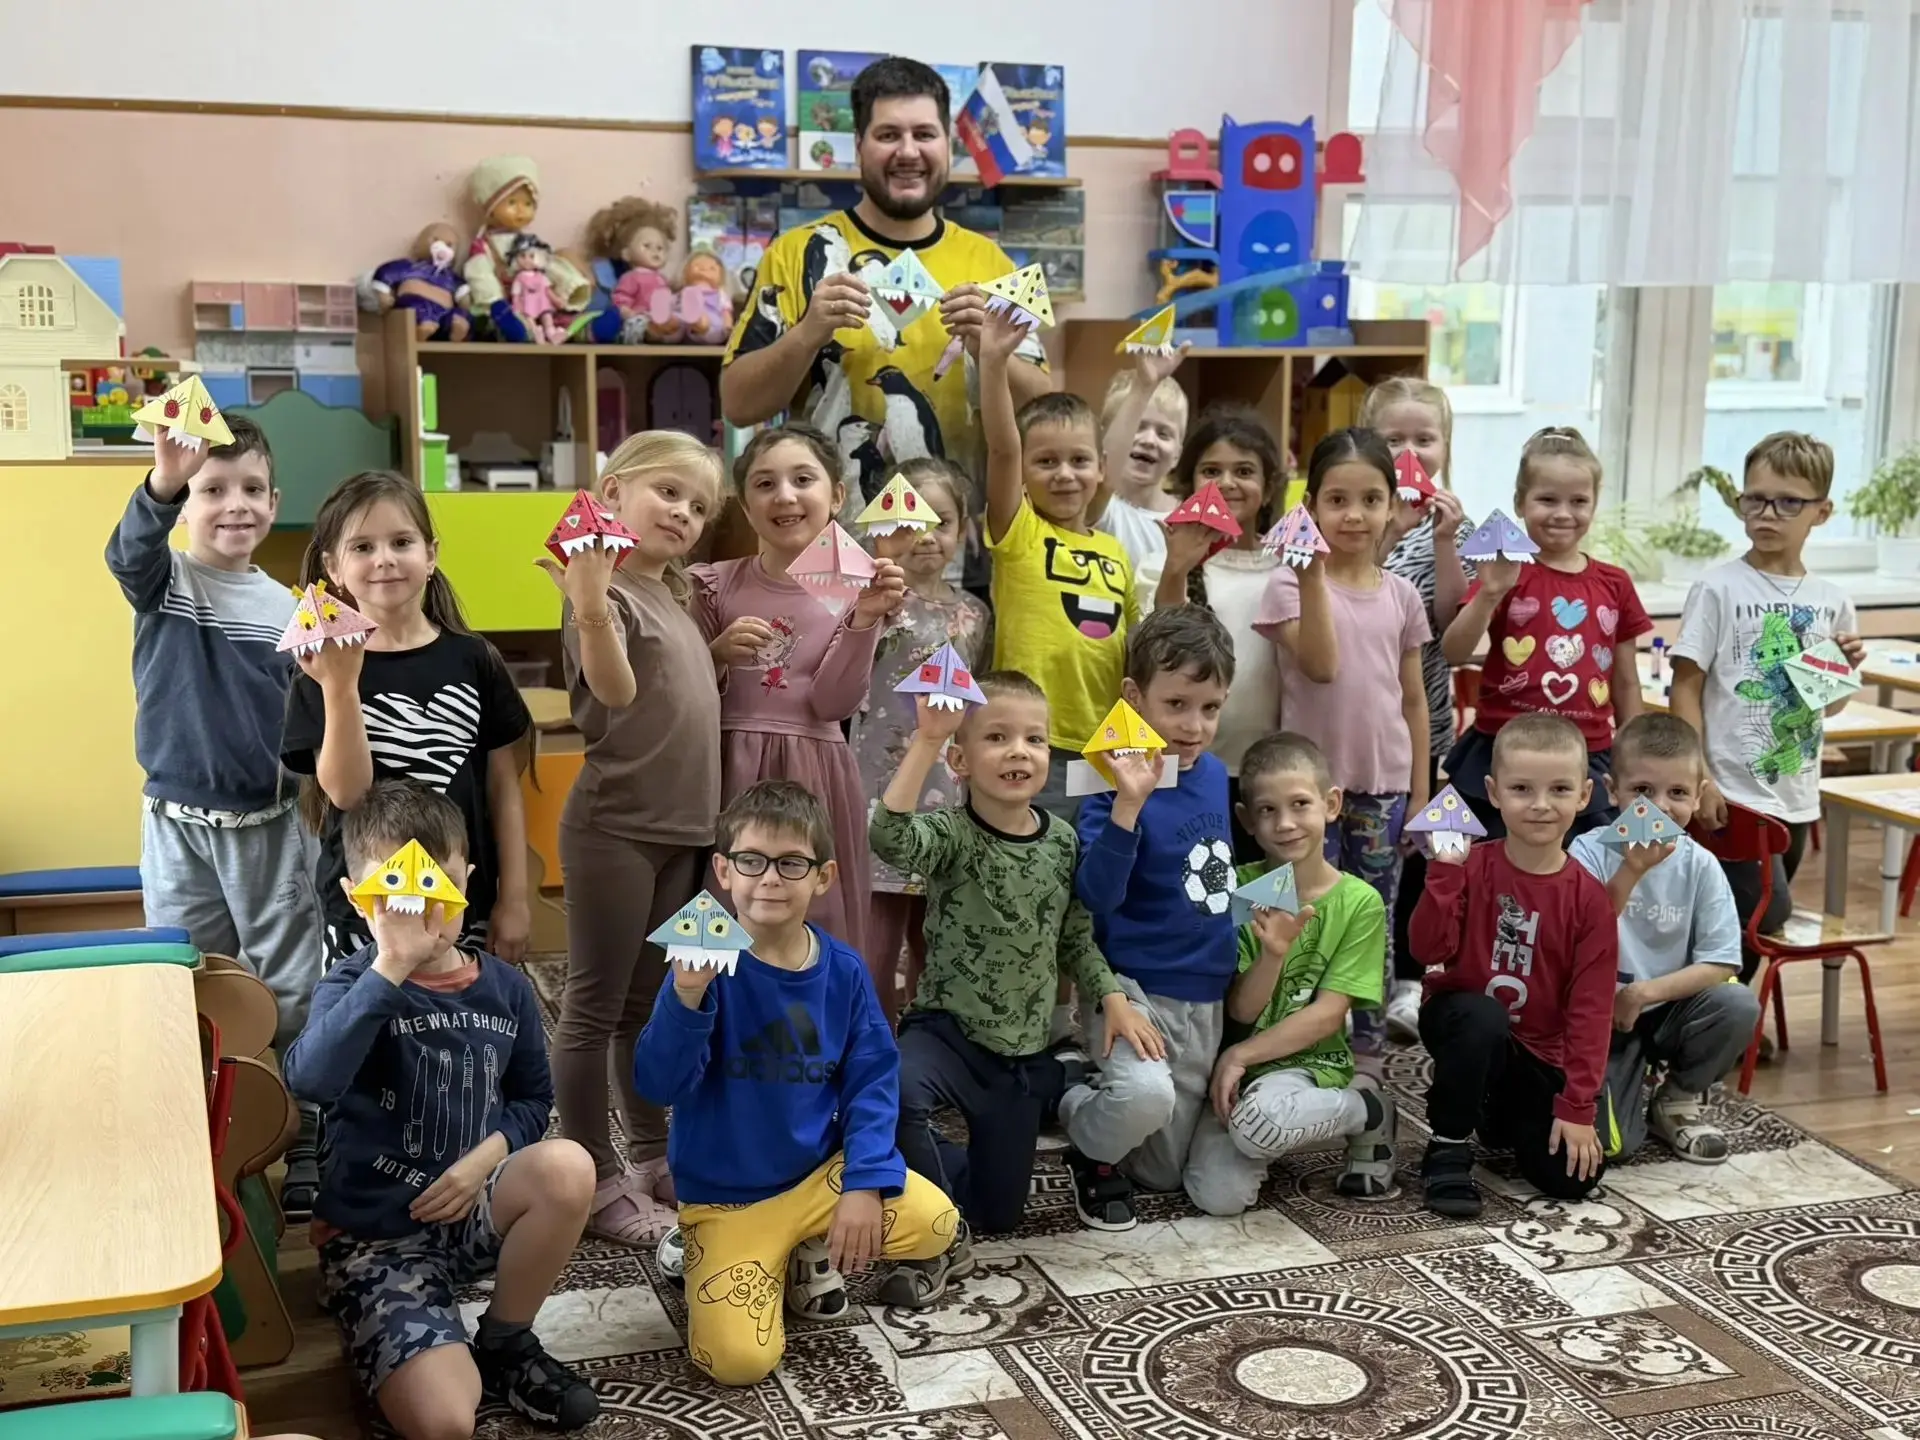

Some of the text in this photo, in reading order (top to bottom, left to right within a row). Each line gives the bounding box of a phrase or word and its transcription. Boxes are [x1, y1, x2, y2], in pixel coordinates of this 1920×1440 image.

[1647, 904, 1686, 922] SURF
[979, 924, 1014, 937] T-REX
[427, 1012, 468, 1030] WHAT
[967, 1016, 1001, 1028] T-REX
[372, 1154, 408, 1178] NOT
[405, 1168, 426, 1188] BE
